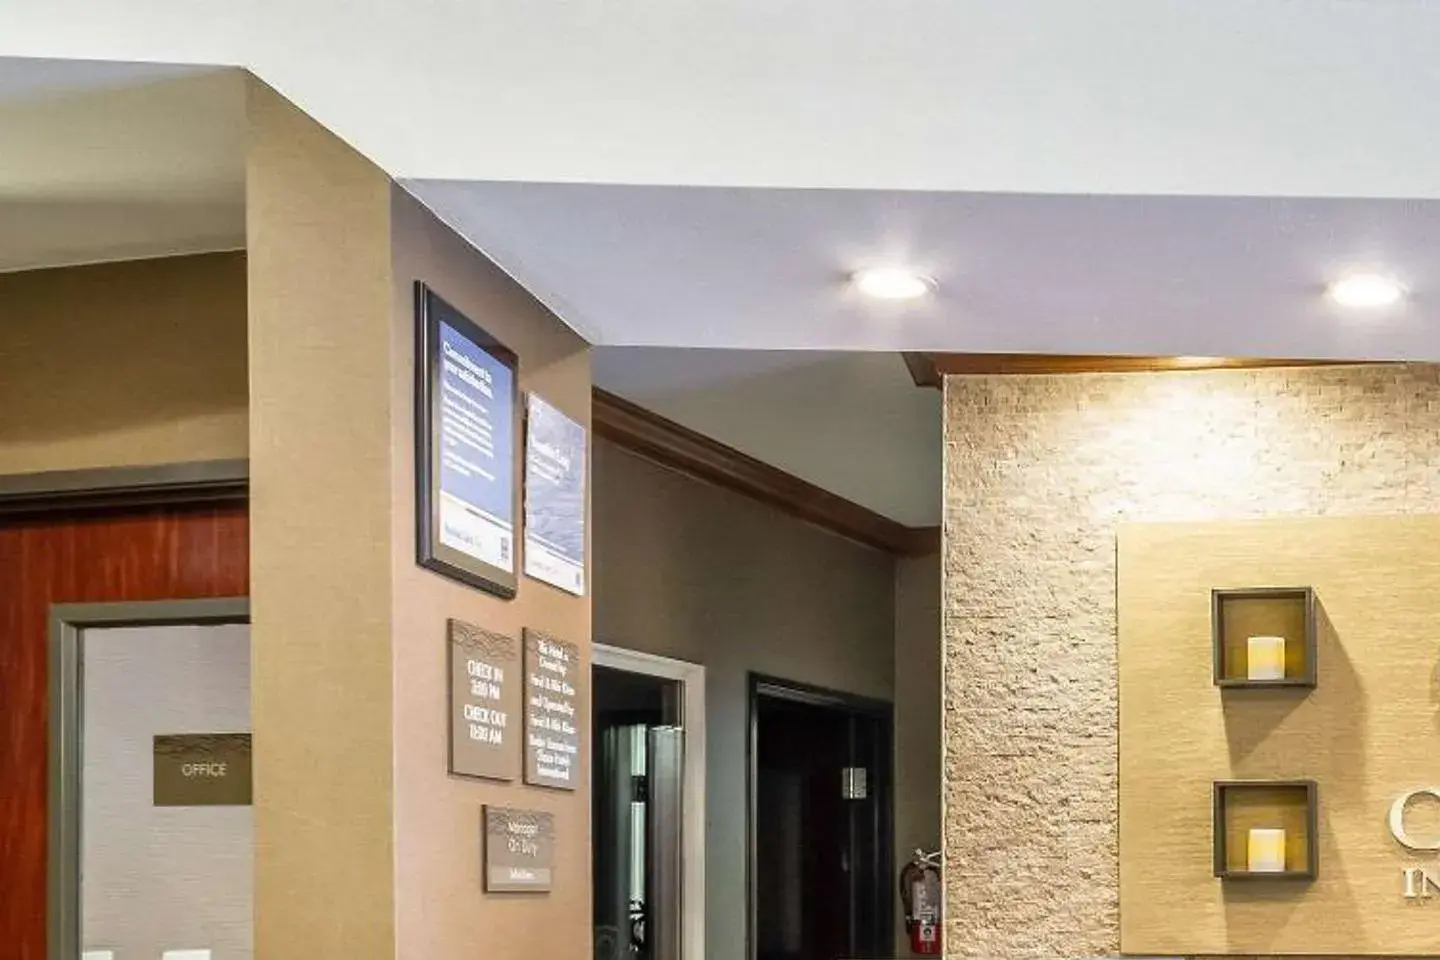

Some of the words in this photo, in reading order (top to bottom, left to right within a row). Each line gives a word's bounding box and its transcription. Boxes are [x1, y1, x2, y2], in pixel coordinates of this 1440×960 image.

[467, 659, 492, 681] CHECK
[464, 703, 490, 724] CHECK
[490, 709, 508, 729] OUT
[181, 762, 228, 777] OFFICE
